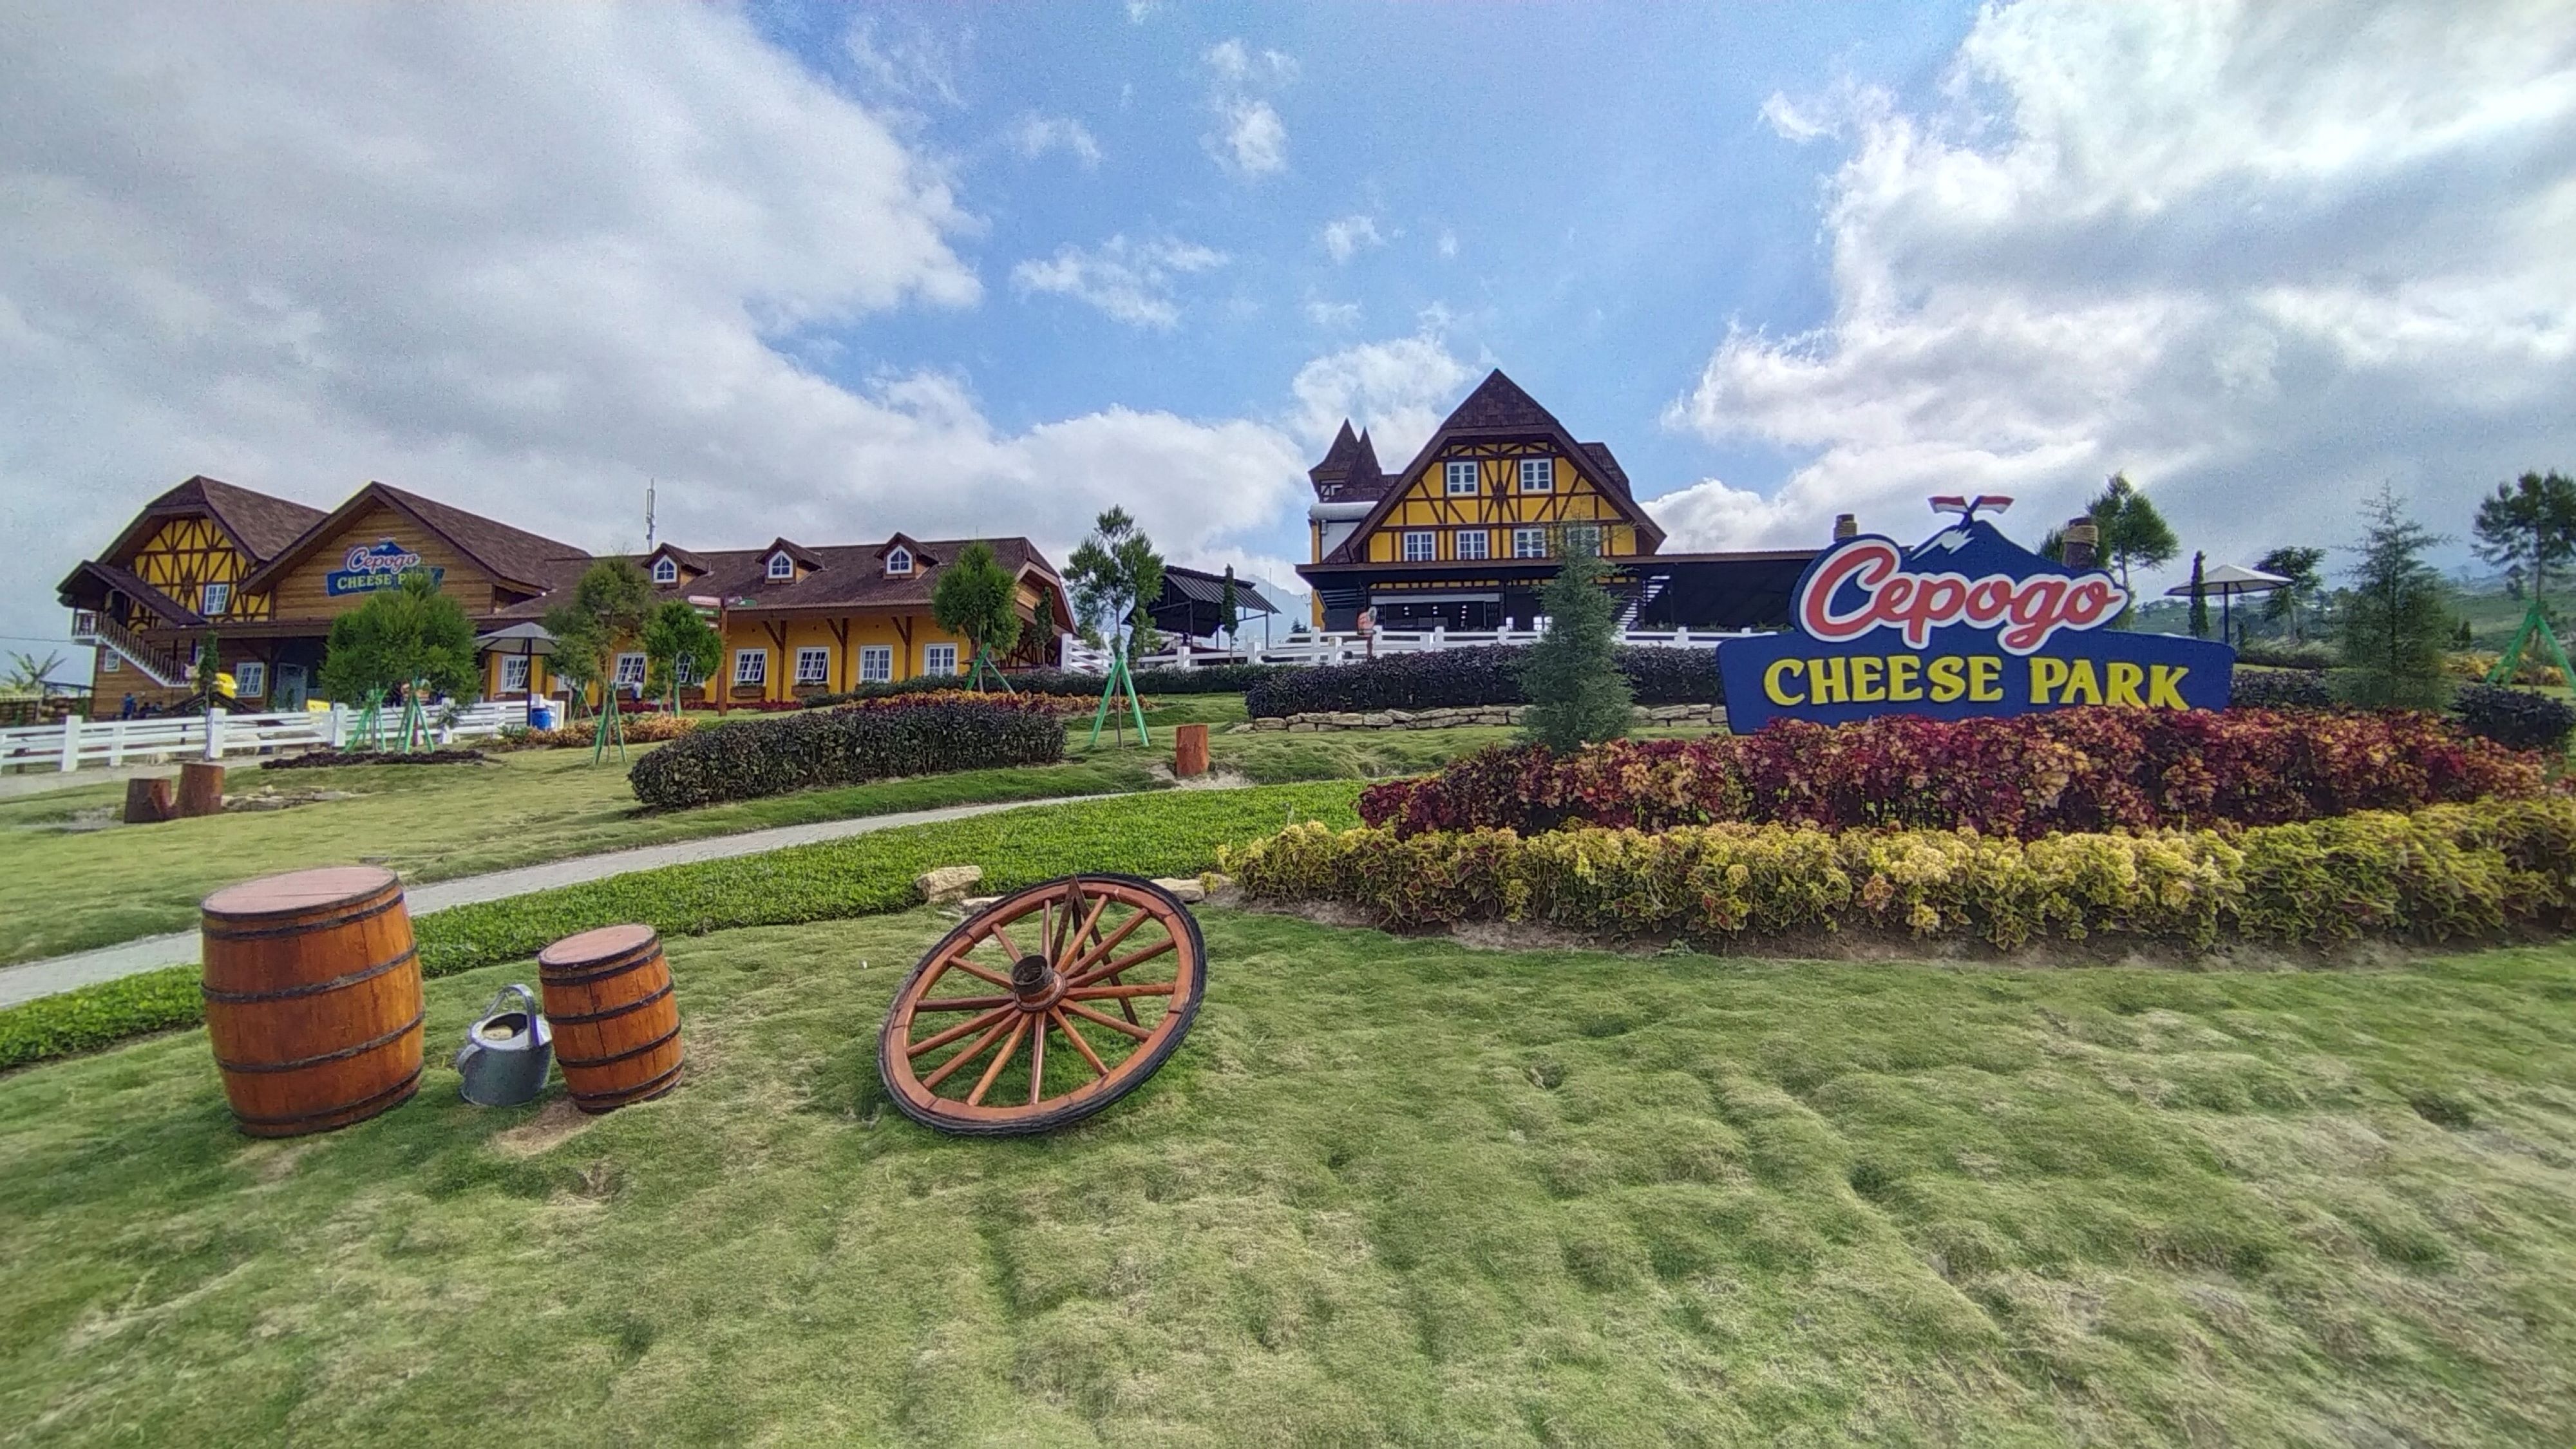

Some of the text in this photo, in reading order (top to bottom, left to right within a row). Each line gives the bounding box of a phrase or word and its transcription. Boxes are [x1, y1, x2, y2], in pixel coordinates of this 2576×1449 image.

[348, 548, 419, 573] Cepogo
[337, 573, 392, 589] CHEESE
[1805, 545, 2125, 650] Cepogo
[1763, 654, 2190, 710] CHEESE PARK
